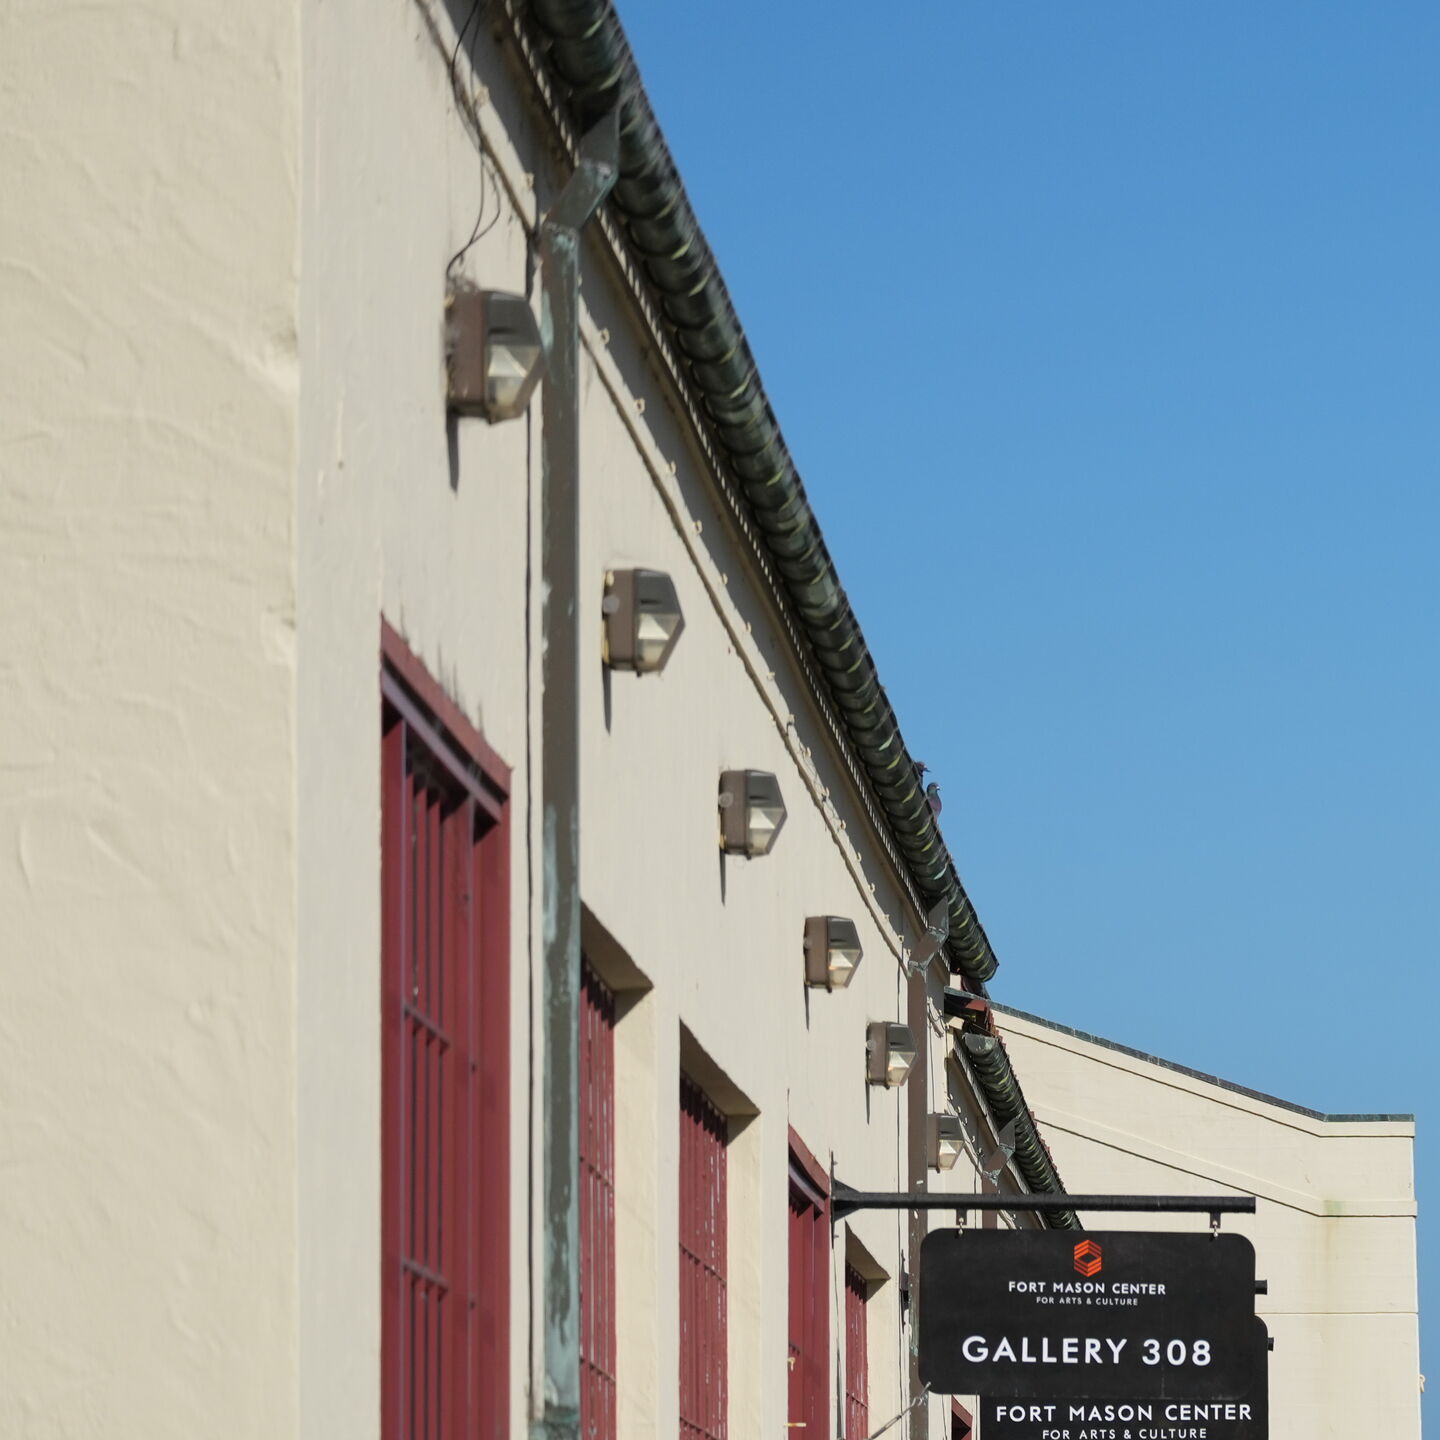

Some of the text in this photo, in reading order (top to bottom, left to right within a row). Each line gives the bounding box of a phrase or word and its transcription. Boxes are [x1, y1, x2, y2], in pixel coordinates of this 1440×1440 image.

[1008, 1281, 1166, 1295] FORT MASON CENTER
[1036, 1296, 1139, 1306] FOR ARTS & CULTURE
[961, 1335, 1211, 1366] GALLERY 308
[996, 1404, 1252, 1422] FORT MASON CENTER
[1042, 1428, 1207, 1440] FOR ARTS & CULTURE
